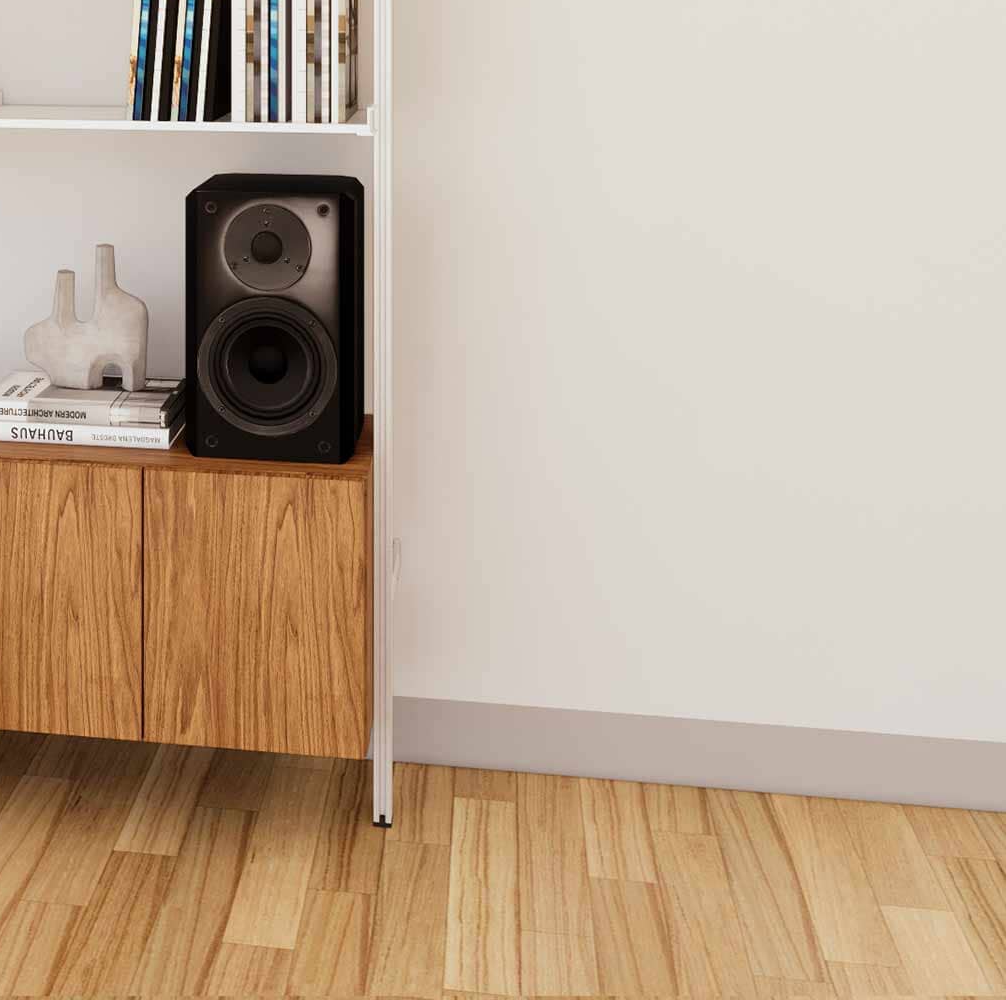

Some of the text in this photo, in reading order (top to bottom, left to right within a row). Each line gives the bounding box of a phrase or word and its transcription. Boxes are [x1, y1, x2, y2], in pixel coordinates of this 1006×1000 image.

[0, 408, 87, 419] MODERN ARCHITECTURE
[10, 426, 74, 442] BAUHAUS
